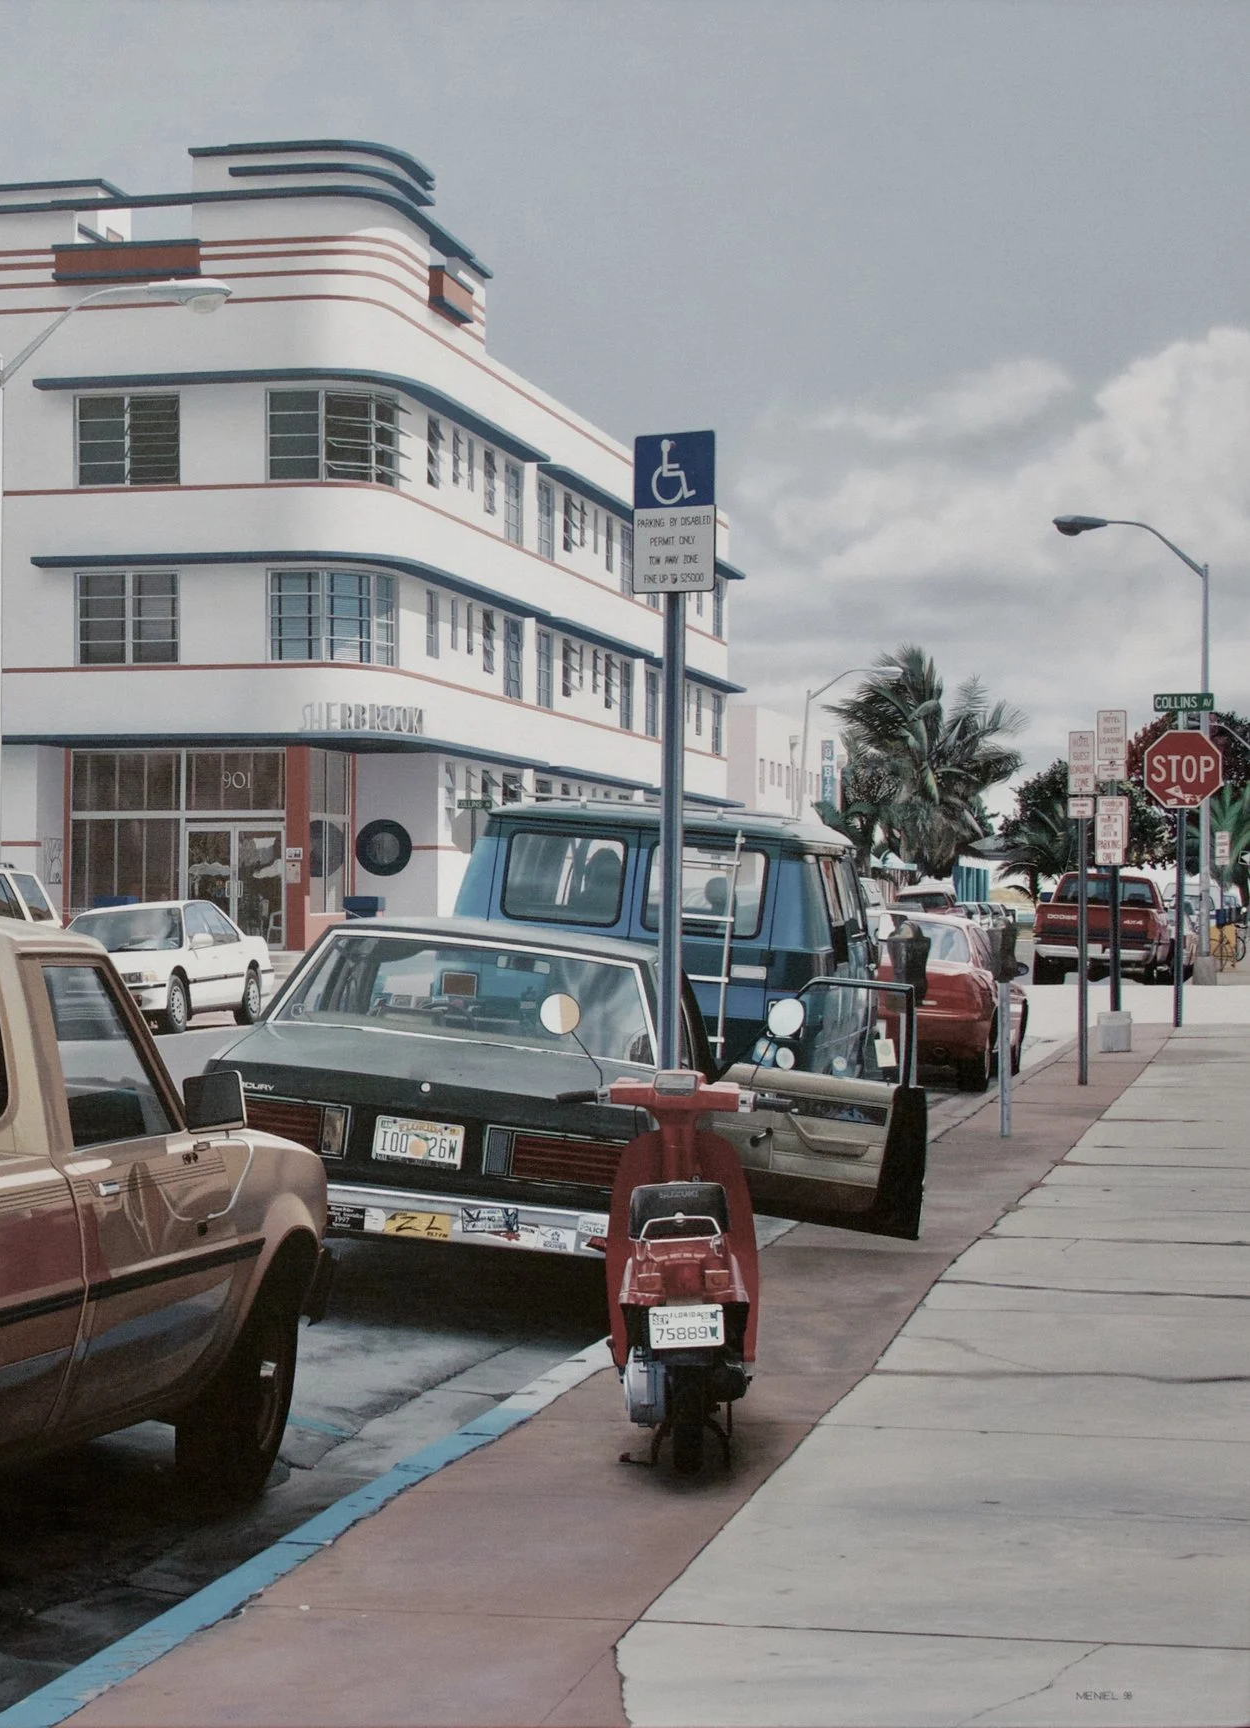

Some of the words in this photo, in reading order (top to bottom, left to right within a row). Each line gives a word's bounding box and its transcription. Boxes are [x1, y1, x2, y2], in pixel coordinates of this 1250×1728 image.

[636, 518, 666, 529] PARKING
[669, 517, 678, 527] BY
[680, 515, 712, 527] DISABLED
[649, 535, 675, 547] PERMIT
[678, 535, 696, 546] ONLY
[649, 555, 661, 566] TOW
[664, 555, 680, 565] AWAY
[683, 553, 699, 565] ZONE
[643, 573, 657, 585] FINE
[659, 573, 669, 584] UP
[1154, 695, 1199, 710] COLLINS
[1202, 697, 1213, 709] AV
[1150, 754, 1216, 784] STOP
[221, 771, 251, 789] 901
[1047, 913, 1078, 921] DODGE
[428, 1136, 458, 1160] 26W
[579, 1224, 605, 1235] POLICE
[669, 1311, 701, 1319] FLORIDA
